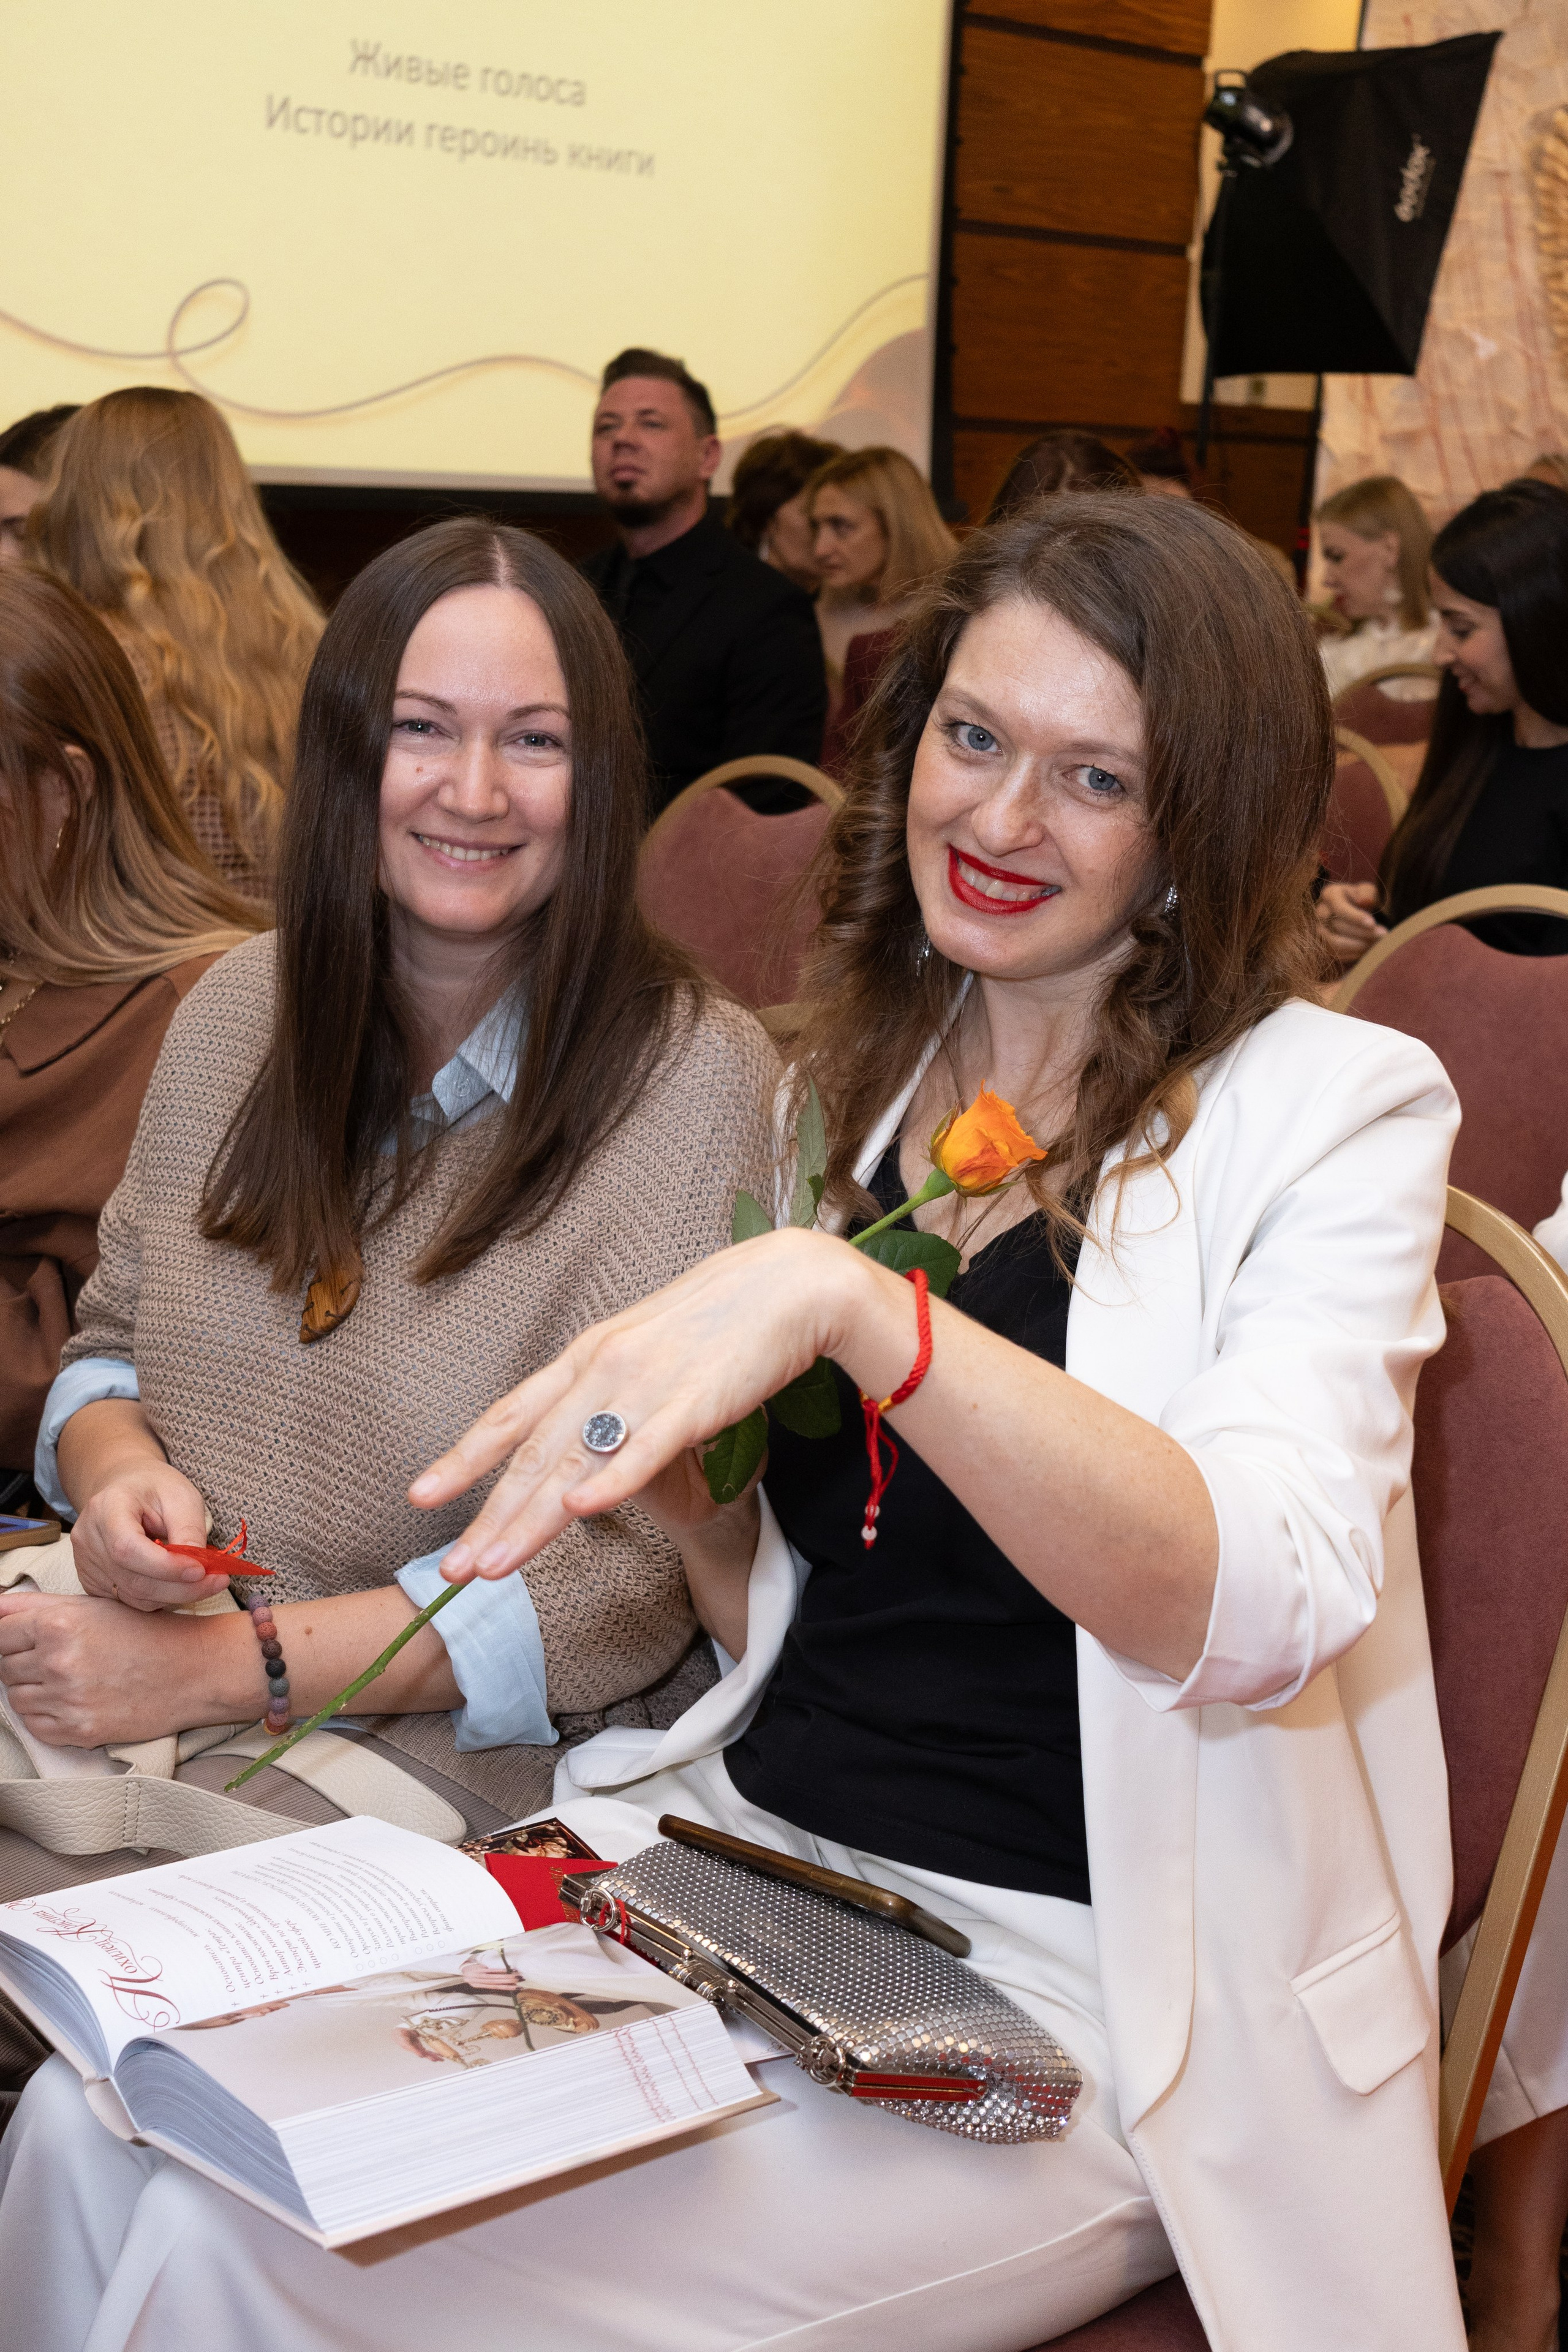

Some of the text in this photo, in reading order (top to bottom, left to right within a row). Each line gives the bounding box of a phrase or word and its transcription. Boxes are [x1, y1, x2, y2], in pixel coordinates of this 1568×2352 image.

[349, 38, 587, 108] Живые голоса
[264, 92, 657, 178] Истории героинь книги
[296, 1901, 320, 1921] МОЖНО
[384, 1898, 418, 1942] Выстраивание
[407, 1907, 429, 1939] Развитие
[421, 1907, 441, 1936] Вопросы
[439, 1913, 454, 1932] фики
[260, 1929, 278, 1948] книги
[318, 1922, 332, 1937] МНЕ
[329, 1937, 342, 1949] КО
[333, 1921, 360, 1958] Открытие
[342, 1913, 371, 1955] Организация
[367, 1927, 382, 1950] Запуск
[373, 1917, 395, 1948] Различия
[393, 1925, 407, 1945] тром
[203, 1943, 236, 1993] Основатель
[235, 1939, 265, 1985] Основатель
[274, 1949, 293, 1977] Автор
[284, 1939, 307, 1973] Эксперт
[297, 1937, 322, 1969] цинской
[32, 1907, 181, 2032] Похилец Кристина
[228, 1956, 251, 1989] центра
